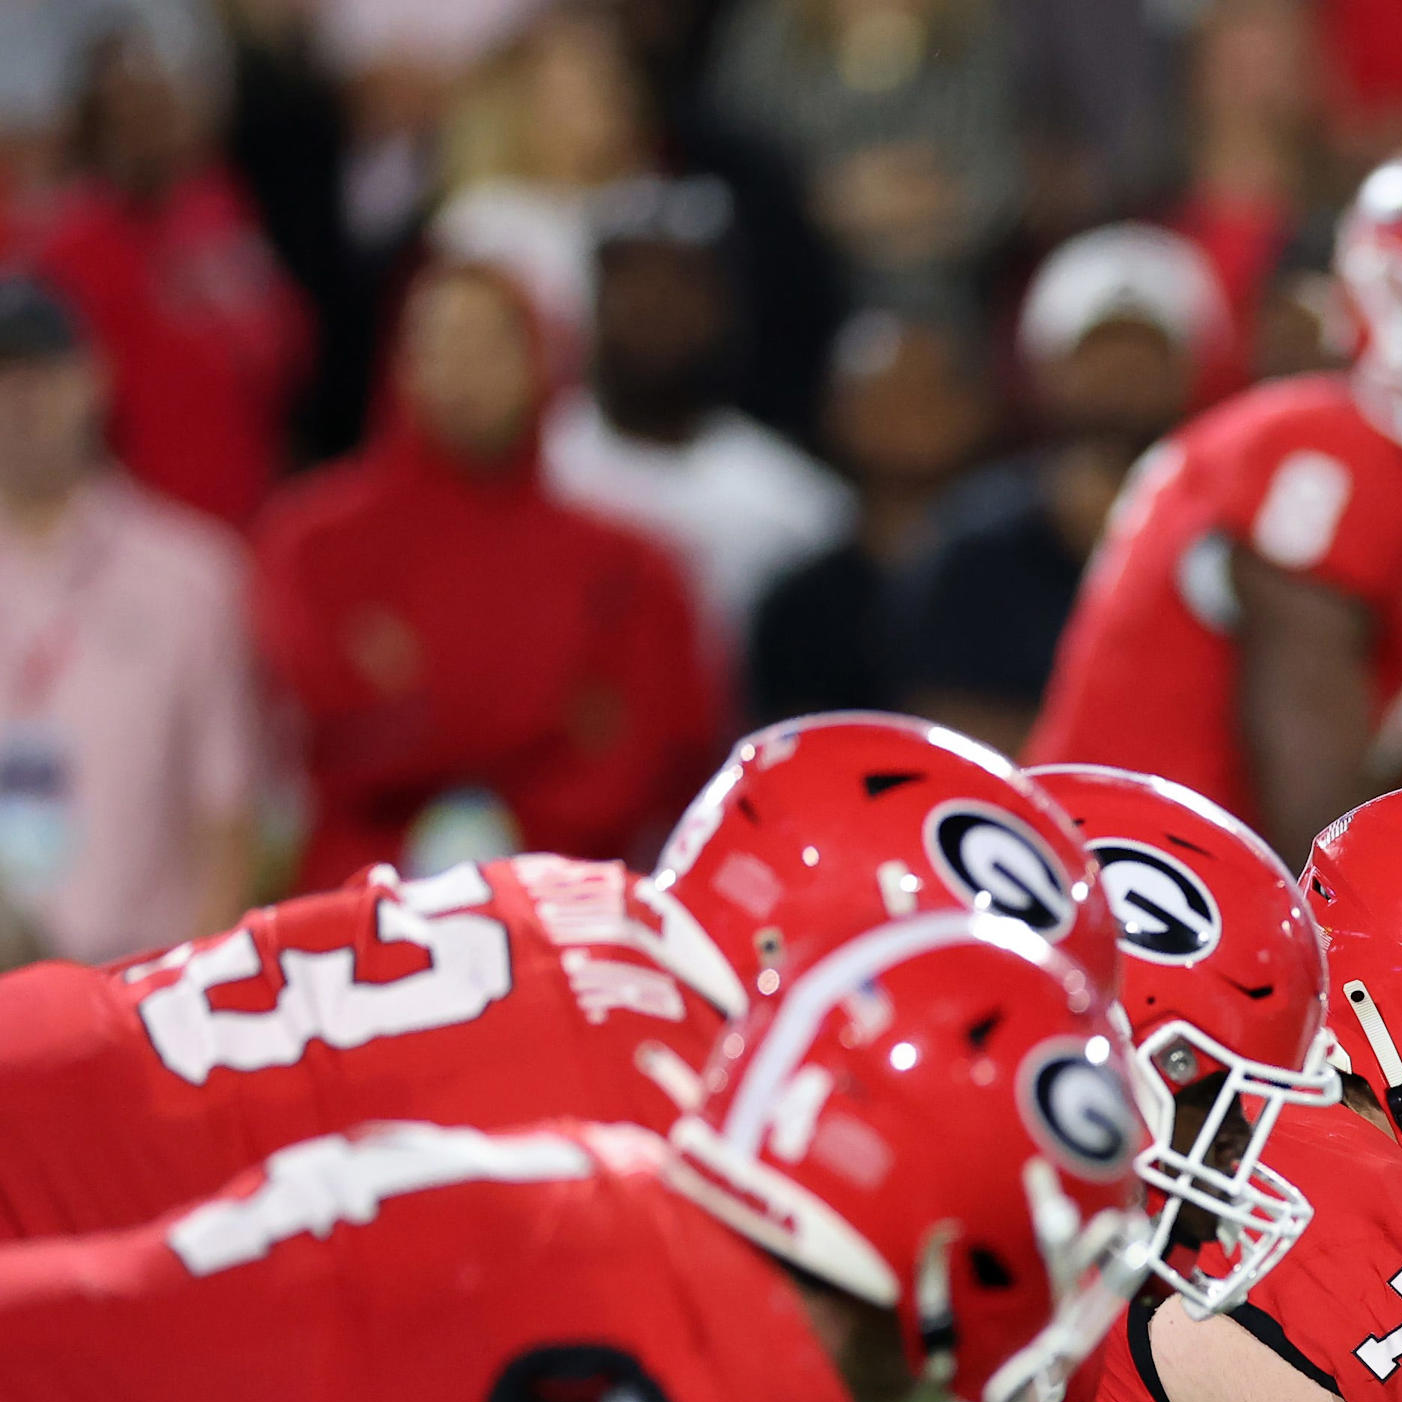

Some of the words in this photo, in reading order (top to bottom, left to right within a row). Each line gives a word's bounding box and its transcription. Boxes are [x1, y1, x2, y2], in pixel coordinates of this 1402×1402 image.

[932, 806, 1066, 936] G
[1088, 844, 1215, 958] G
[1028, 1048, 1134, 1168] G
